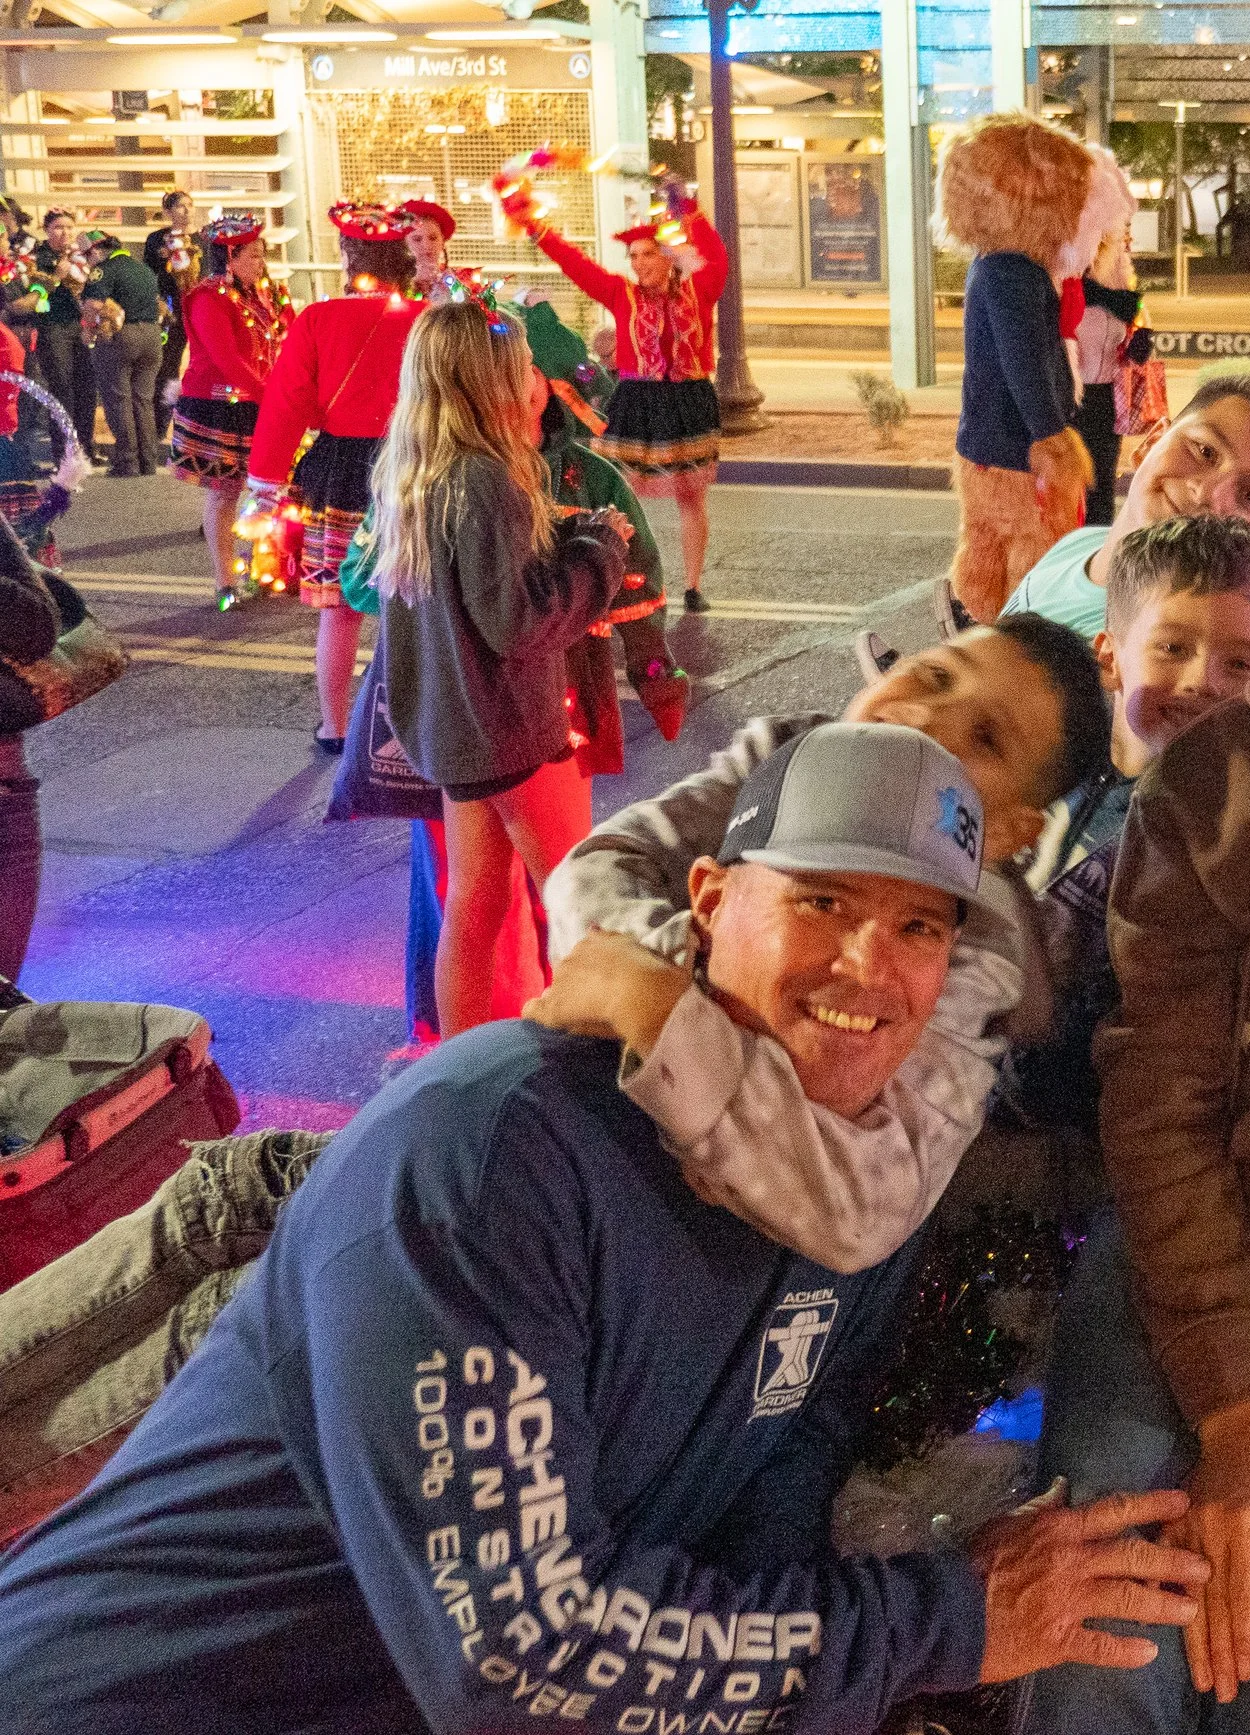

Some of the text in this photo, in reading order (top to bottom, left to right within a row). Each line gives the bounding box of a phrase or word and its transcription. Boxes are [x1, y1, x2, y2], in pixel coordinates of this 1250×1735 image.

[384, 54, 507, 77] Mill Ave/3rd St
[952, 805, 979, 862] 35
[782, 1287, 834, 1304] ACHEN
[414, 1349, 456, 1499] 100%
[427, 1523, 598, 1719] EMPLOYEE
